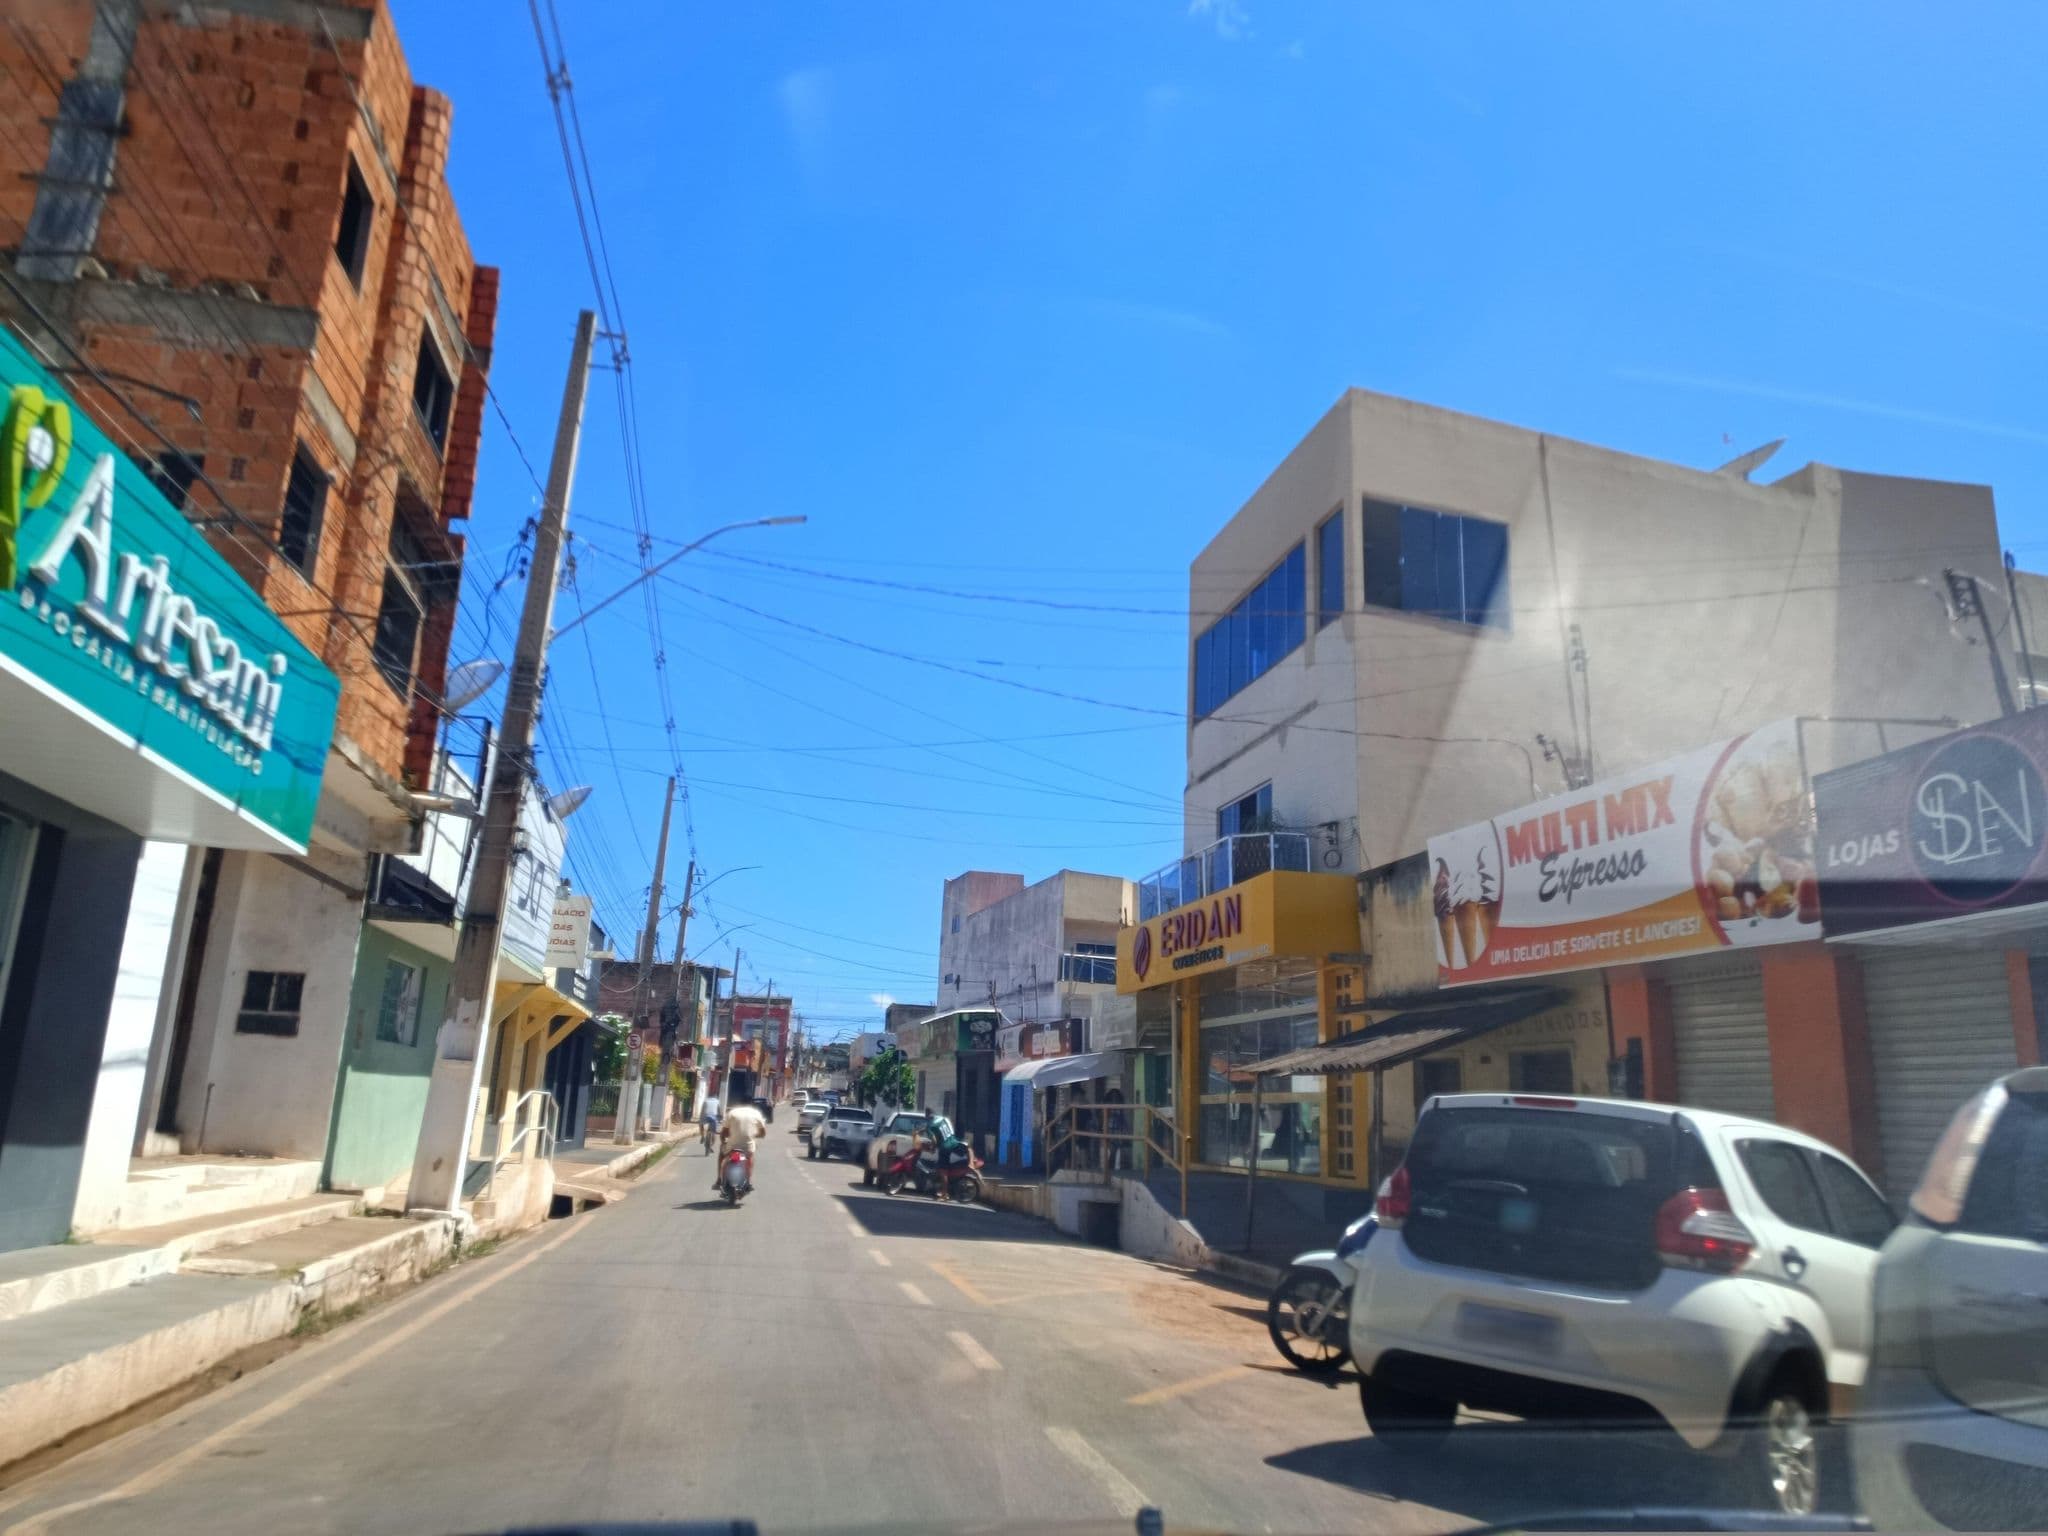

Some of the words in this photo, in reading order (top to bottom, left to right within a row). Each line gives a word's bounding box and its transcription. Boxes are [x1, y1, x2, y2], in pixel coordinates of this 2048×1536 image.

[30, 453, 287, 752] Artesani
[19, 586, 135, 685] DROGARIA
[1505, 800, 1600, 868] MULTI
[1604, 774, 1676, 842] MIX
[1828, 830, 1900, 867] LOJAS
[1538, 848, 1648, 905] Expresso
[1161, 893, 1242, 958] ERIDAN
[1490, 950, 1511, 966] UMA
[1553, 939, 1568, 957] DE
[1570, 931, 1620, 955] SORVETE
[1623, 929, 1632, 945] E
